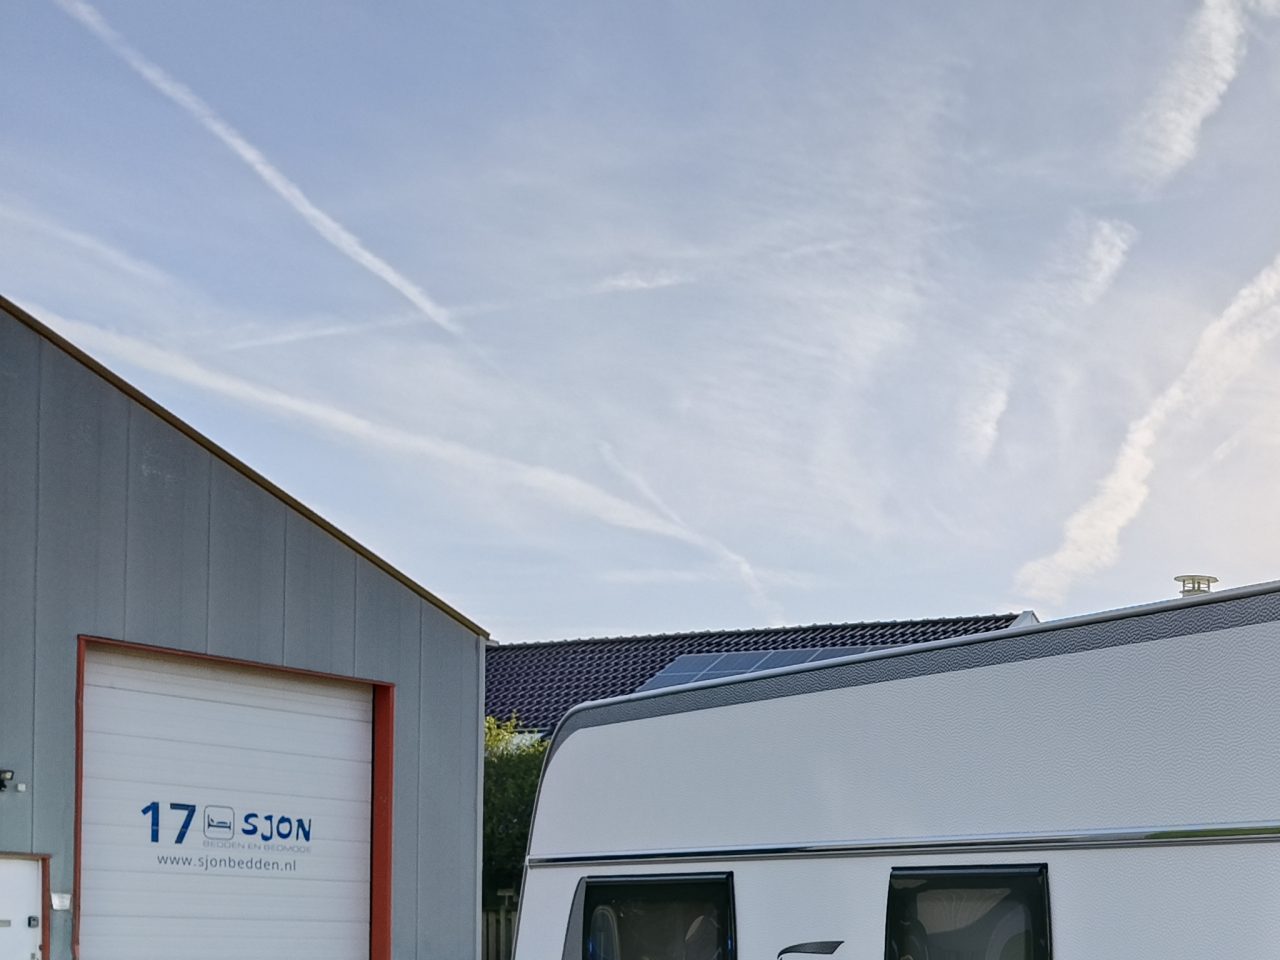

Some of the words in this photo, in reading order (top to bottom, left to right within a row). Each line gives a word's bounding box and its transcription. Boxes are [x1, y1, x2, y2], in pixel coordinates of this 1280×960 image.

[141, 801, 196, 844] 17
[241, 813, 312, 842] SJON
[157, 855, 297, 872] www.sjonbedden.nl
